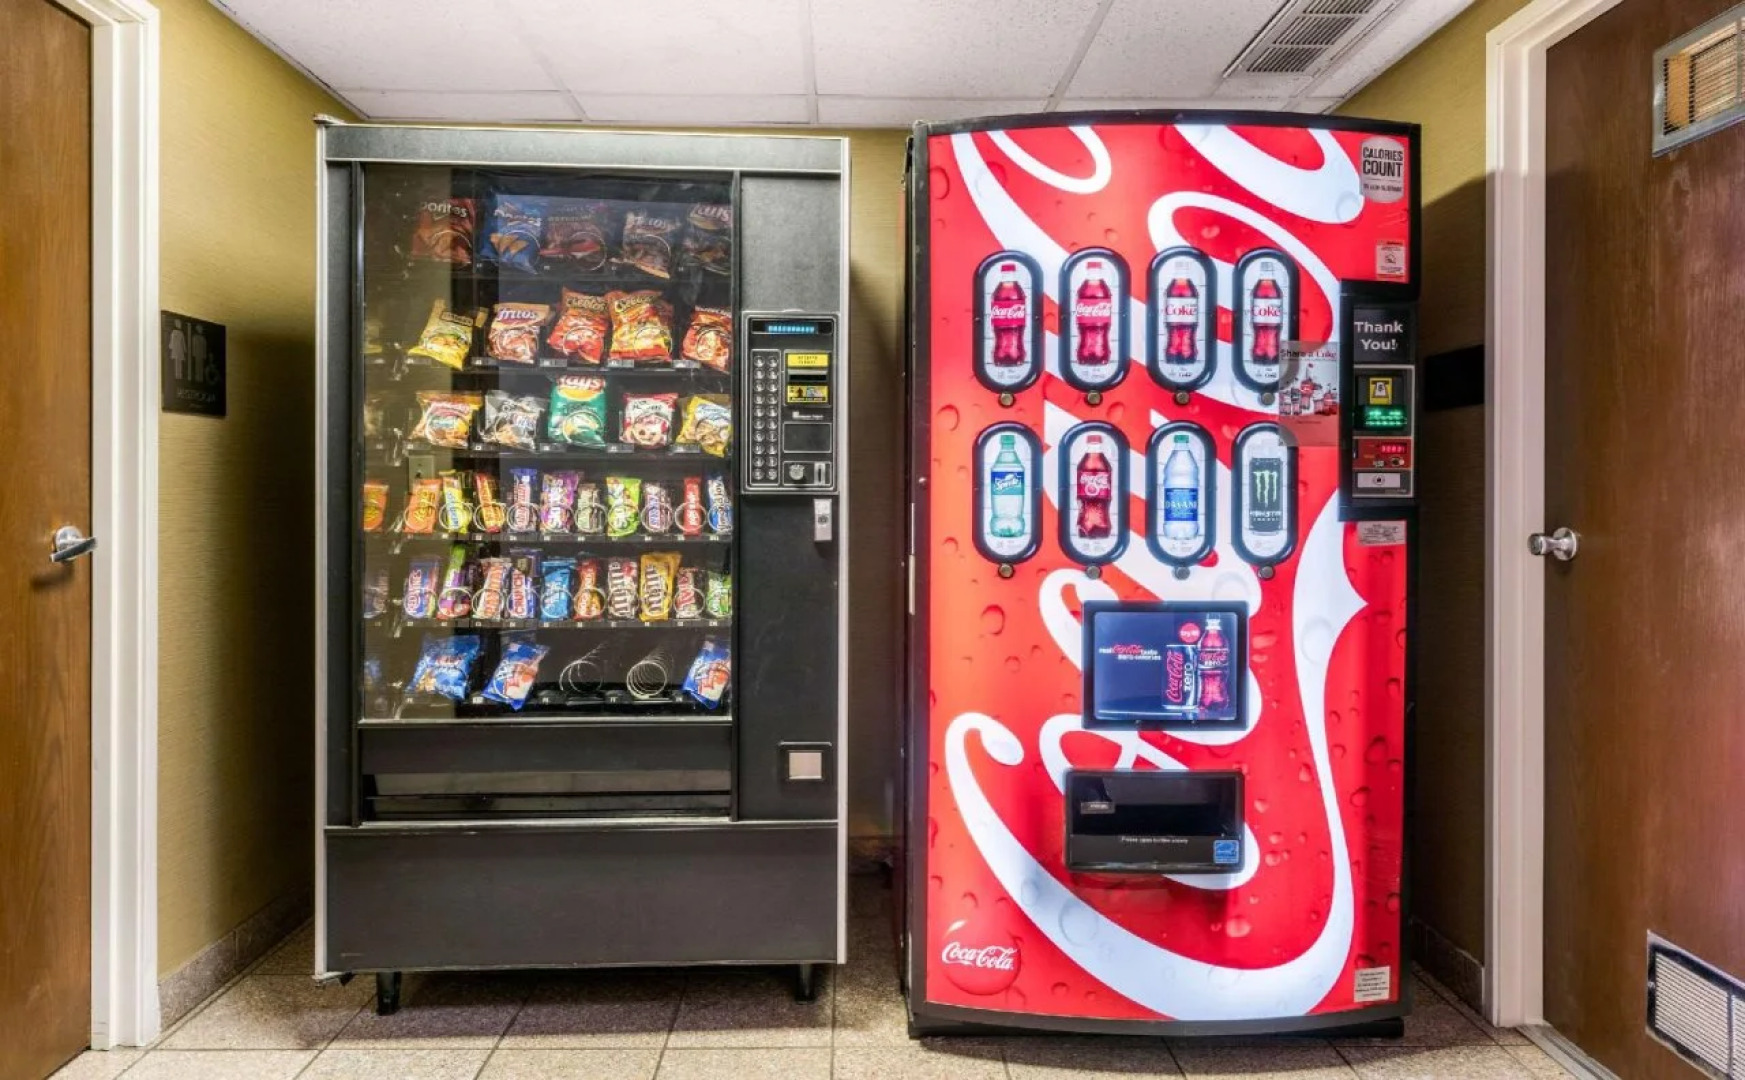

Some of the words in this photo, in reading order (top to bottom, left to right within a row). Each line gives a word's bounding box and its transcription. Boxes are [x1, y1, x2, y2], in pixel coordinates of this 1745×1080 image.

[1362, 146, 1404, 162] CALORIES
[1362, 160, 1404, 177] COUNT
[1354, 320, 1403, 333] Thank
[1361, 339, 1397, 351] You!
[941, 940, 1018, 971] Coca-Cola
